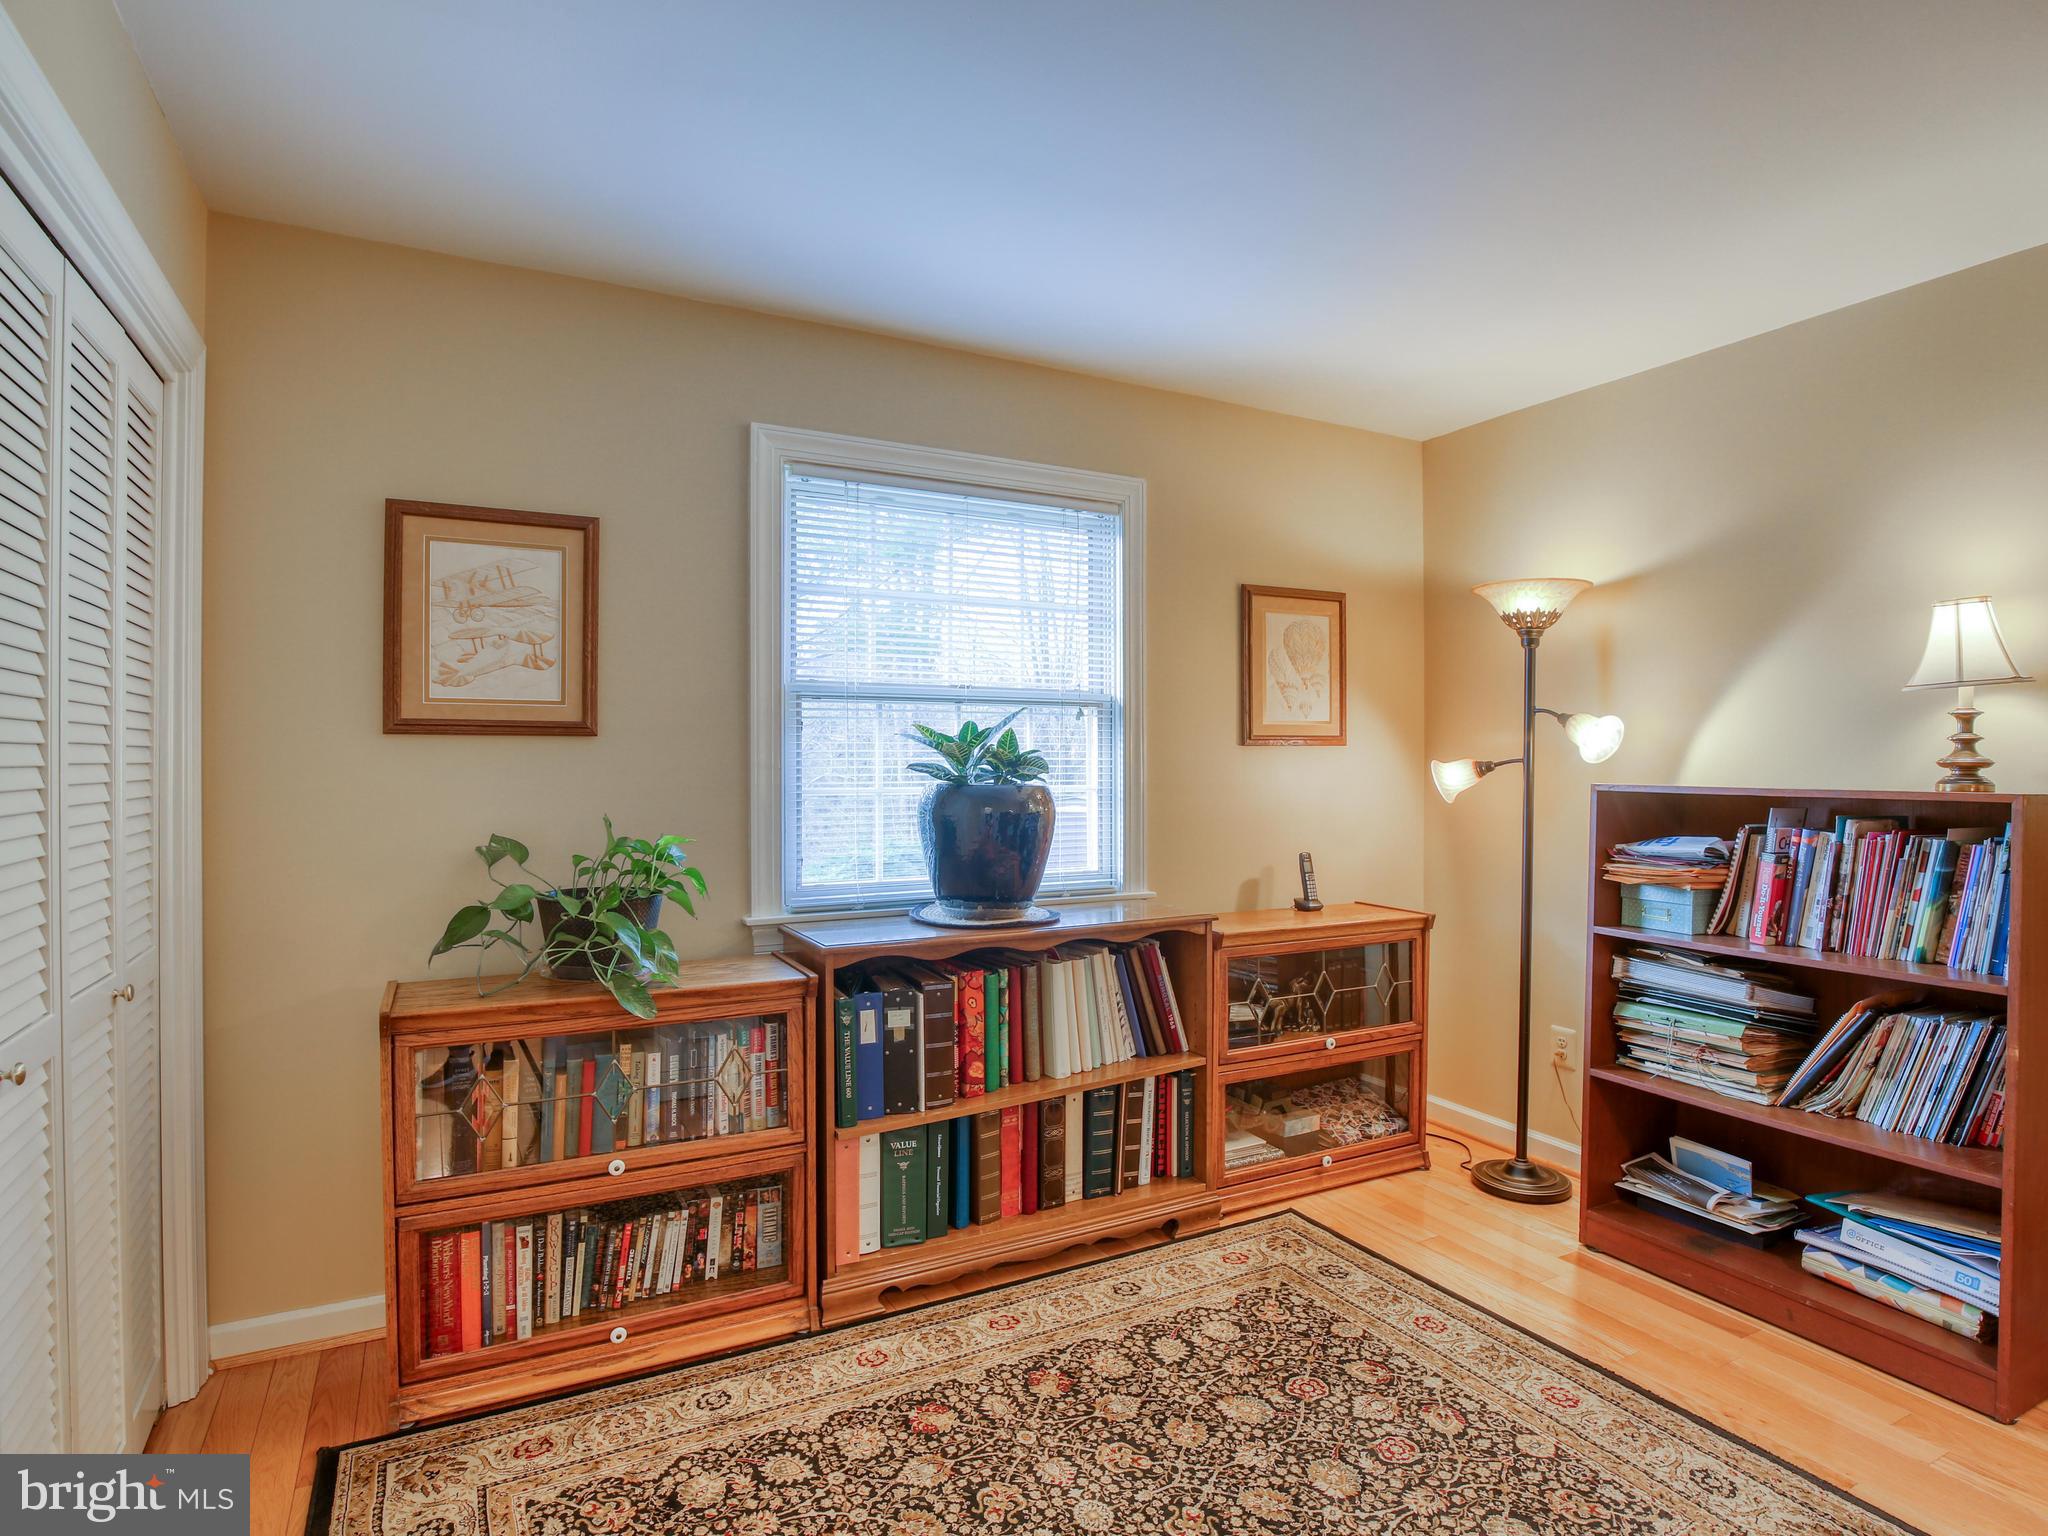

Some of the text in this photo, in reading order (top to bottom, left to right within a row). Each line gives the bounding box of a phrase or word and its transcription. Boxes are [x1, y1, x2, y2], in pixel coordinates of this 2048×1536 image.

[1755, 883, 1769, 938] Do-It-Yourself
[890, 1140, 917, 1150] VALUE
[894, 1149, 914, 1157] LINE
[762, 1206, 778, 1242] TITANIC
[431, 1240, 442, 1286] Dictionary
[626, 1248, 635, 1281] TRAFFIC
[442, 1238, 454, 1327] Webster's New World
